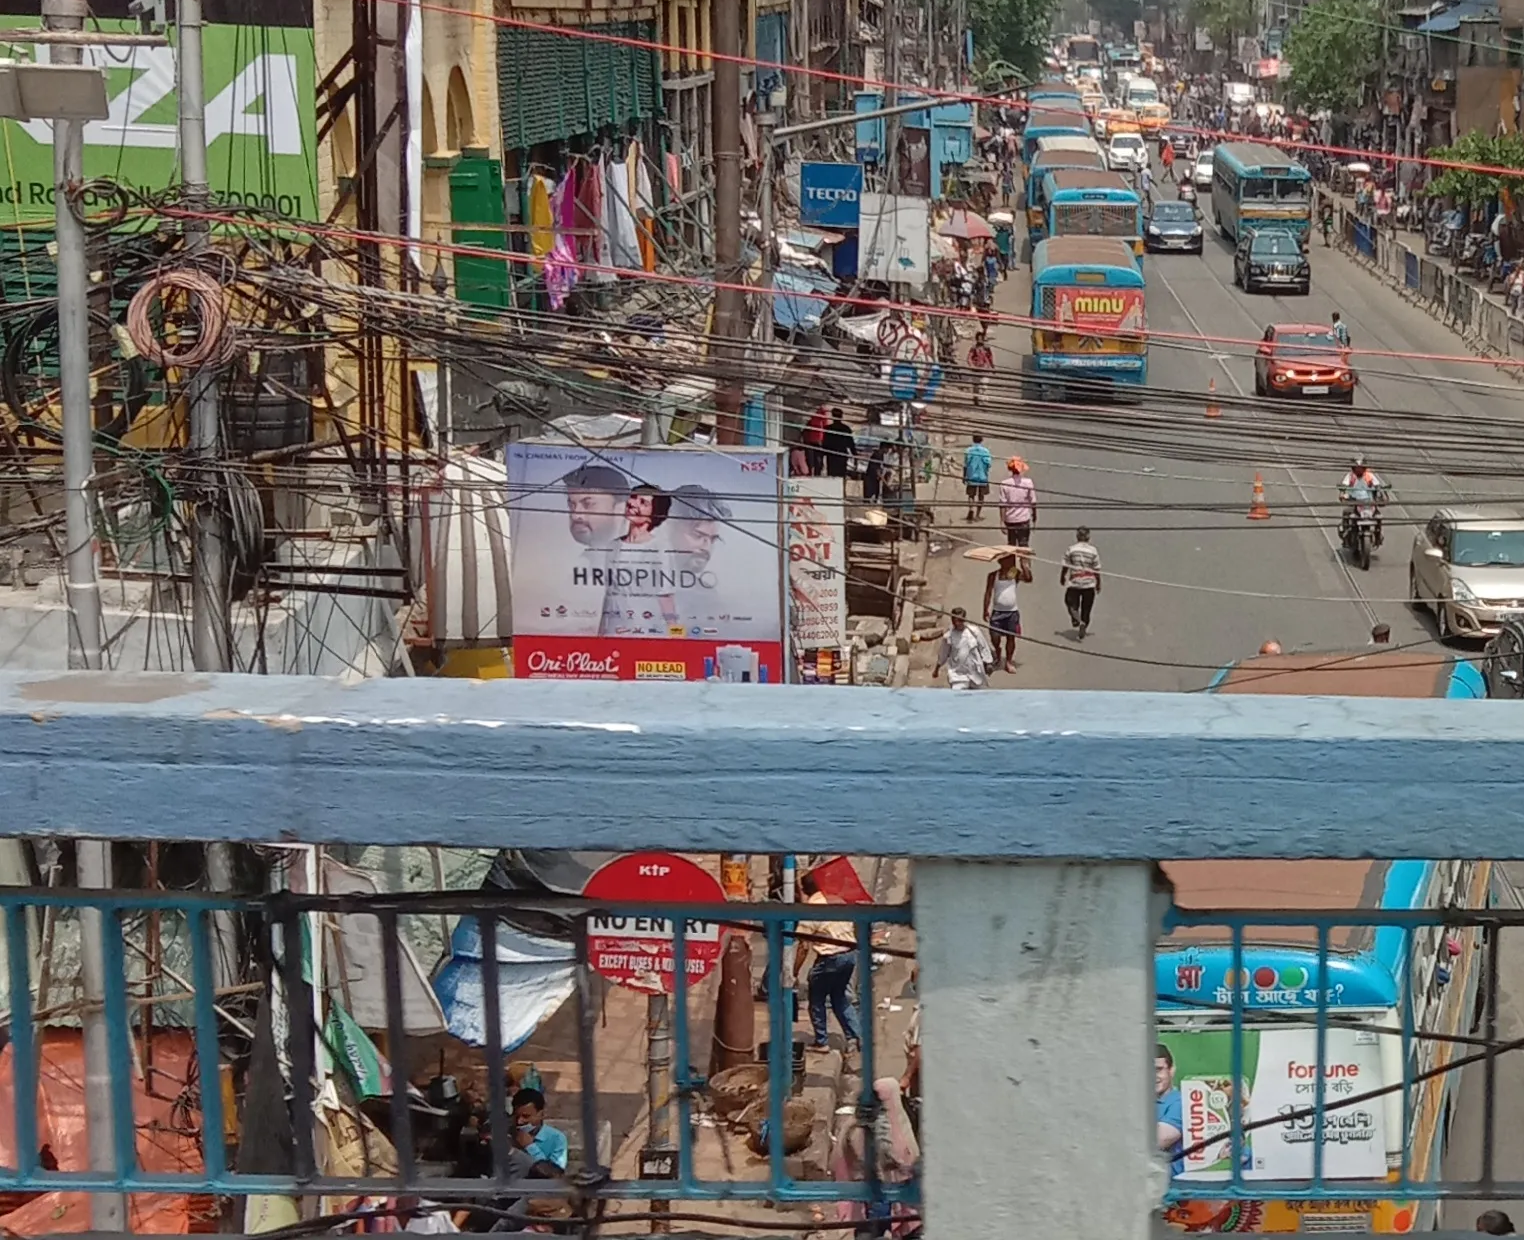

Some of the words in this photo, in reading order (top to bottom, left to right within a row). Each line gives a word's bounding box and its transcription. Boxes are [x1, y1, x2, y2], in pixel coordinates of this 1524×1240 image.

[805, 187, 857, 202] TECNO
[572, 566, 718, 590] HRIDPINDO
[527, 651, 620, 673] Ori-Plast
[637, 662, 653, 673] NO
[656, 662, 684, 674] LEAD
[634, 916, 709, 935] ENRY
[598, 953, 628, 969] EXCEPT
[1288, 1061, 1360, 1079] forune
